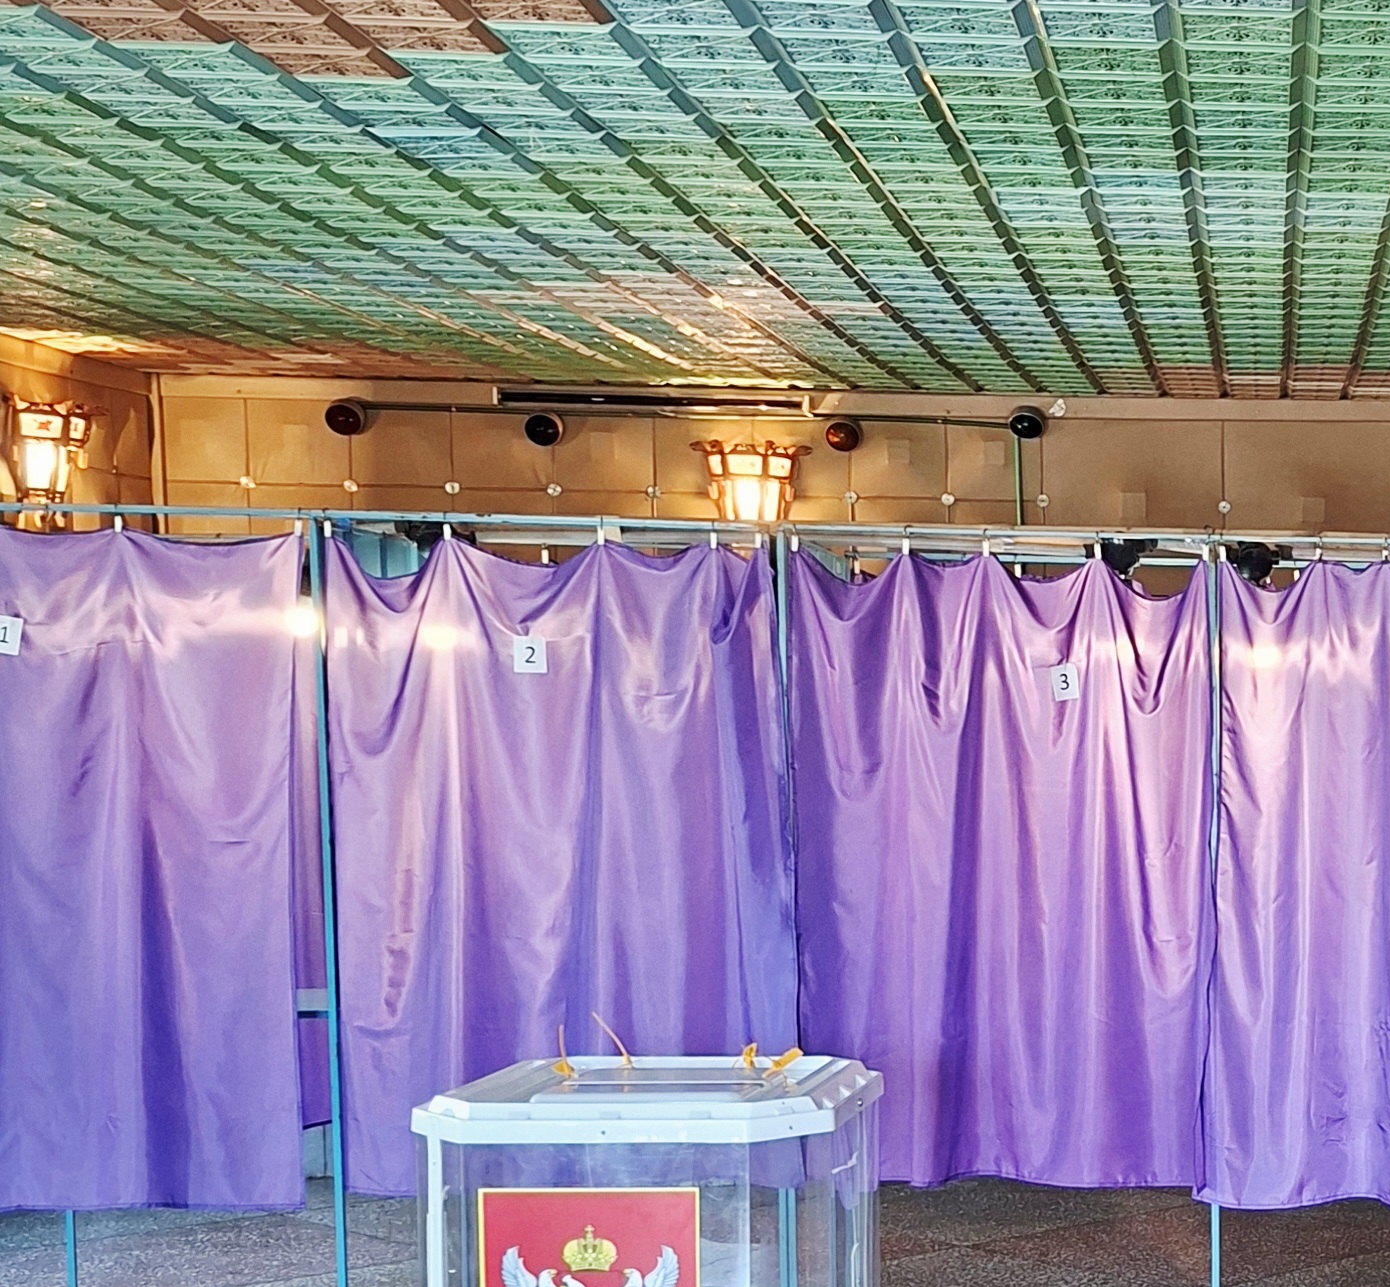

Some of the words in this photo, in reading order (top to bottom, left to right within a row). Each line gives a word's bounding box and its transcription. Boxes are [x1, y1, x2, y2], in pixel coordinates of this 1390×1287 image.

[0, 626, 9, 643] 1
[525, 646, 536, 663] 2
[1059, 673, 1070, 690] 3
